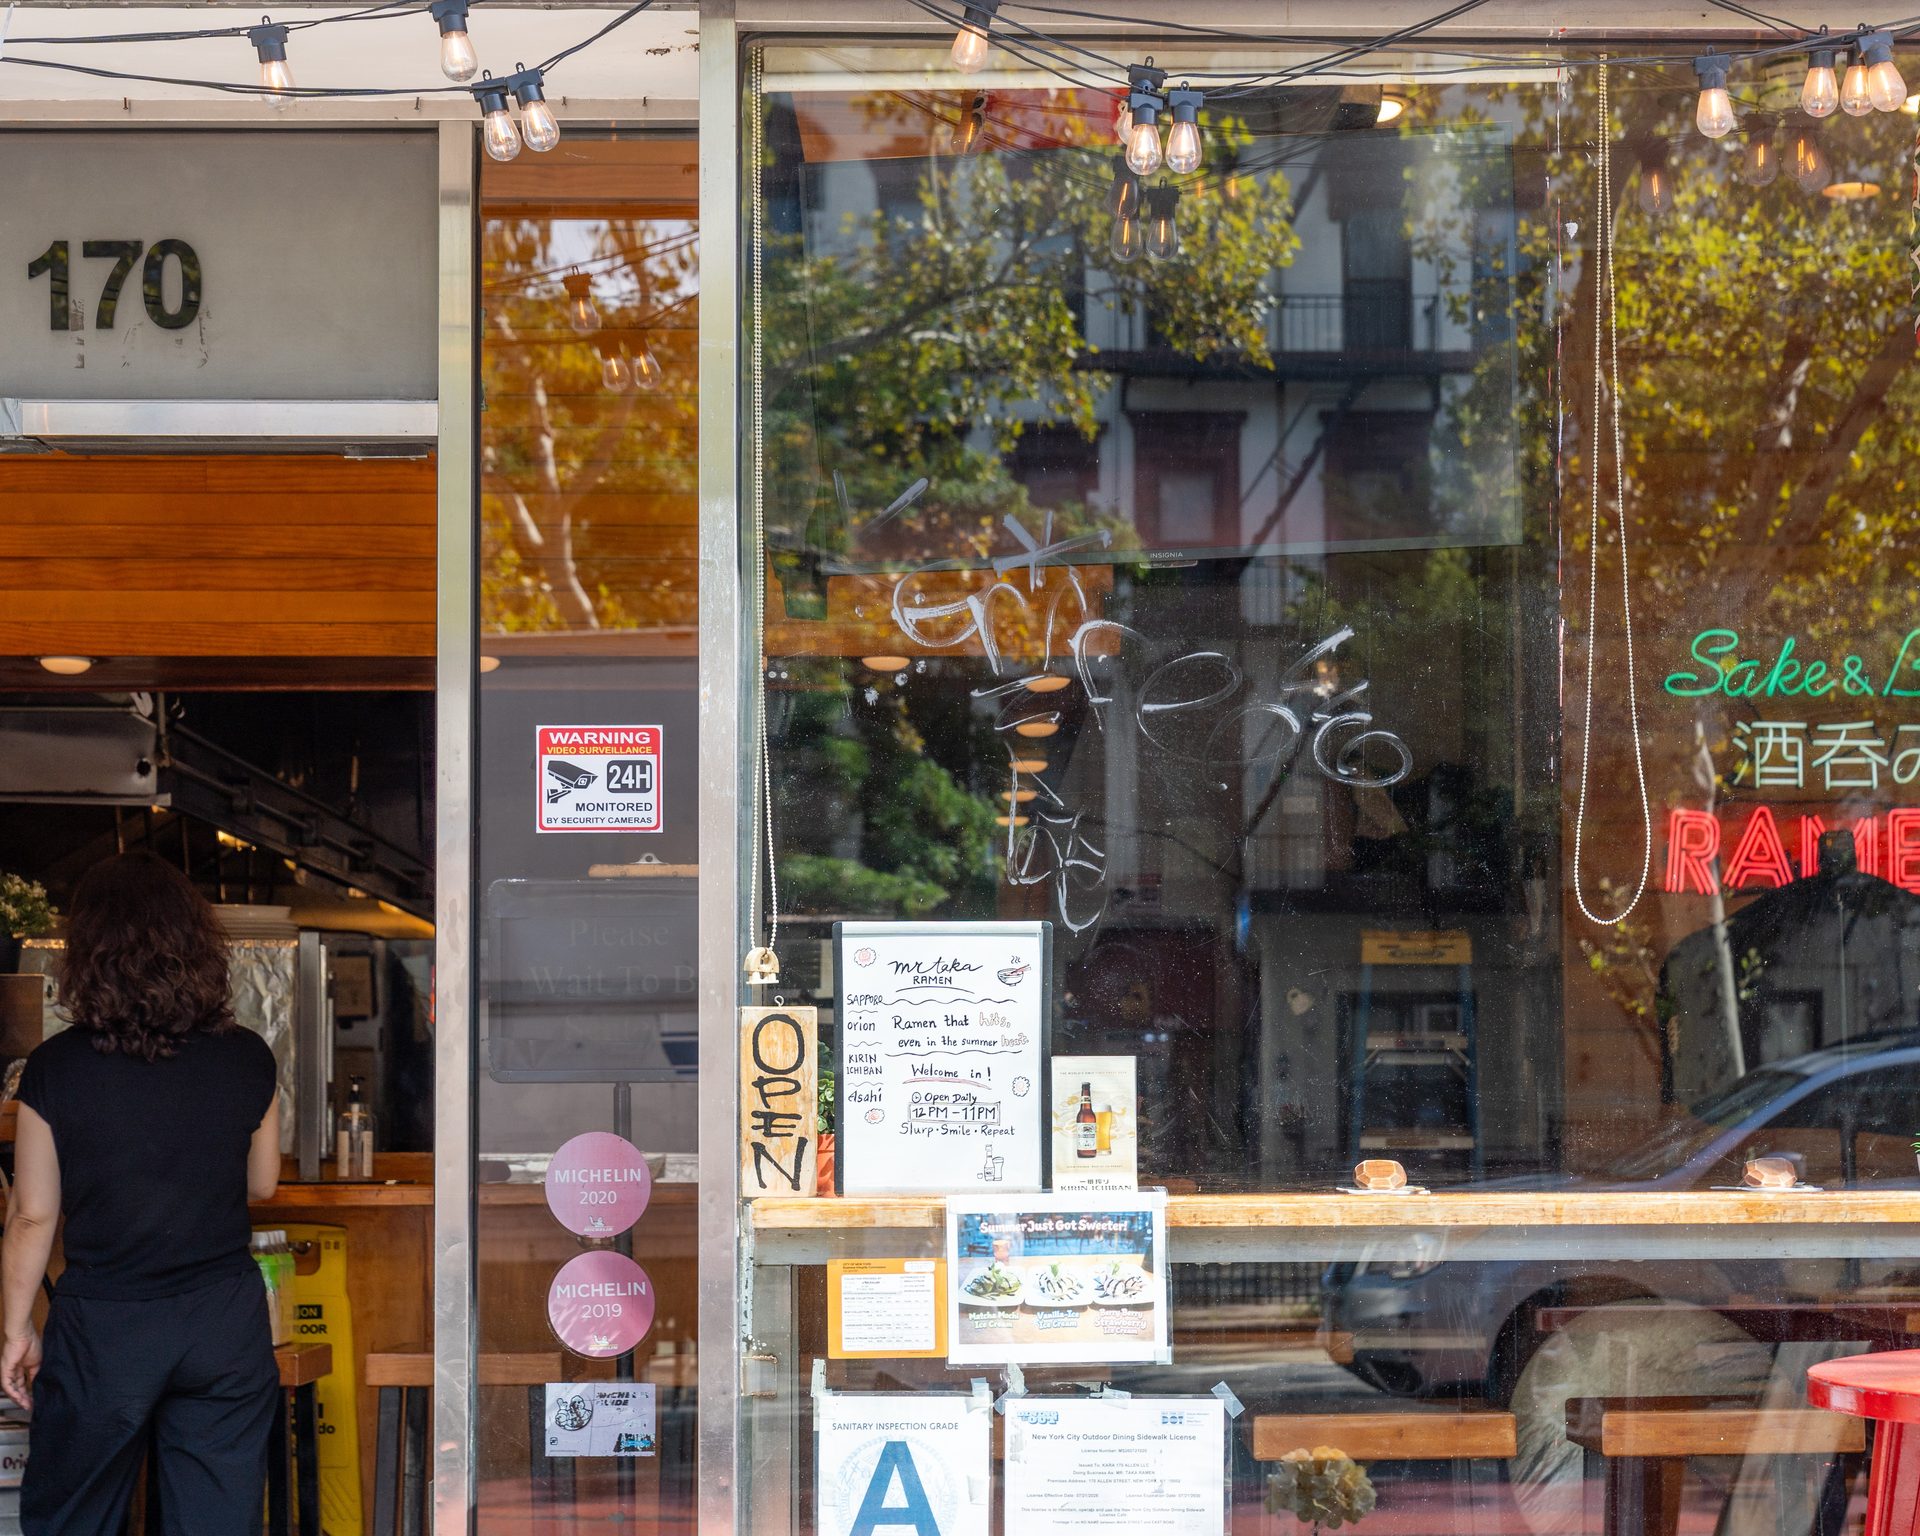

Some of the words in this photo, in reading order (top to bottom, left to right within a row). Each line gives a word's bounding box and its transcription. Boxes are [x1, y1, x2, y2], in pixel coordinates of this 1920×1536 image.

[28, 239, 202, 330] 170
[1664, 628, 1837, 697] Sake
[549, 732, 650, 744] WARNING
[608, 764, 650, 788] 24H
[576, 802, 652, 812] MONITORED
[570, 919, 669, 946] Please
[529, 965, 605, 994] Wait
[618, 965, 660, 994] To
[674, 964, 698, 994] B
[913, 976, 952, 985] RAMEN
[847, 994, 882, 1006] SAPPORO
[892, 1016, 936, 1030] Ramen
[944, 1014, 969, 1026] that
[898, 1038, 921, 1048] even
[926, 1036, 936, 1046] in
[941, 1036, 957, 1046] the
[962, 1038, 998, 1047] summer
[849, 1054, 876, 1063] KIRIN
[846, 1066, 882, 1075] ICHIBAN
[912, 1064, 958, 1078] Welcome
[751, 1014, 808, 1191] OPEN
[924, 1092, 949, 1104] Open
[952, 1092, 977, 1106] Daily
[981, 1125, 1015, 1136] Repeat
[555, 1168, 641, 1183] MICHELIN
[580, 1191, 617, 1204] 2020
[980, 1222, 1027, 1233] Summer
[1026, 1220, 1054, 1232] Just
[1055, 1220, 1078, 1232] Got
[1078, 1219, 1128, 1232] Sweeter!
[556, 1282, 646, 1298] MICHELIN
[582, 1304, 622, 1318] 2019
[968, 1312, 997, 1320] Matcha
[997, 1311, 1020, 1320] Mochi
[1039, 1321, 1051, 1329] Ice
[1161, 1416, 1184, 1424] DOT
[1067, 1434, 1080, 1442] City
[1112, 1434, 1135, 1442] Dining
[849, 1441, 941, 1536] A
